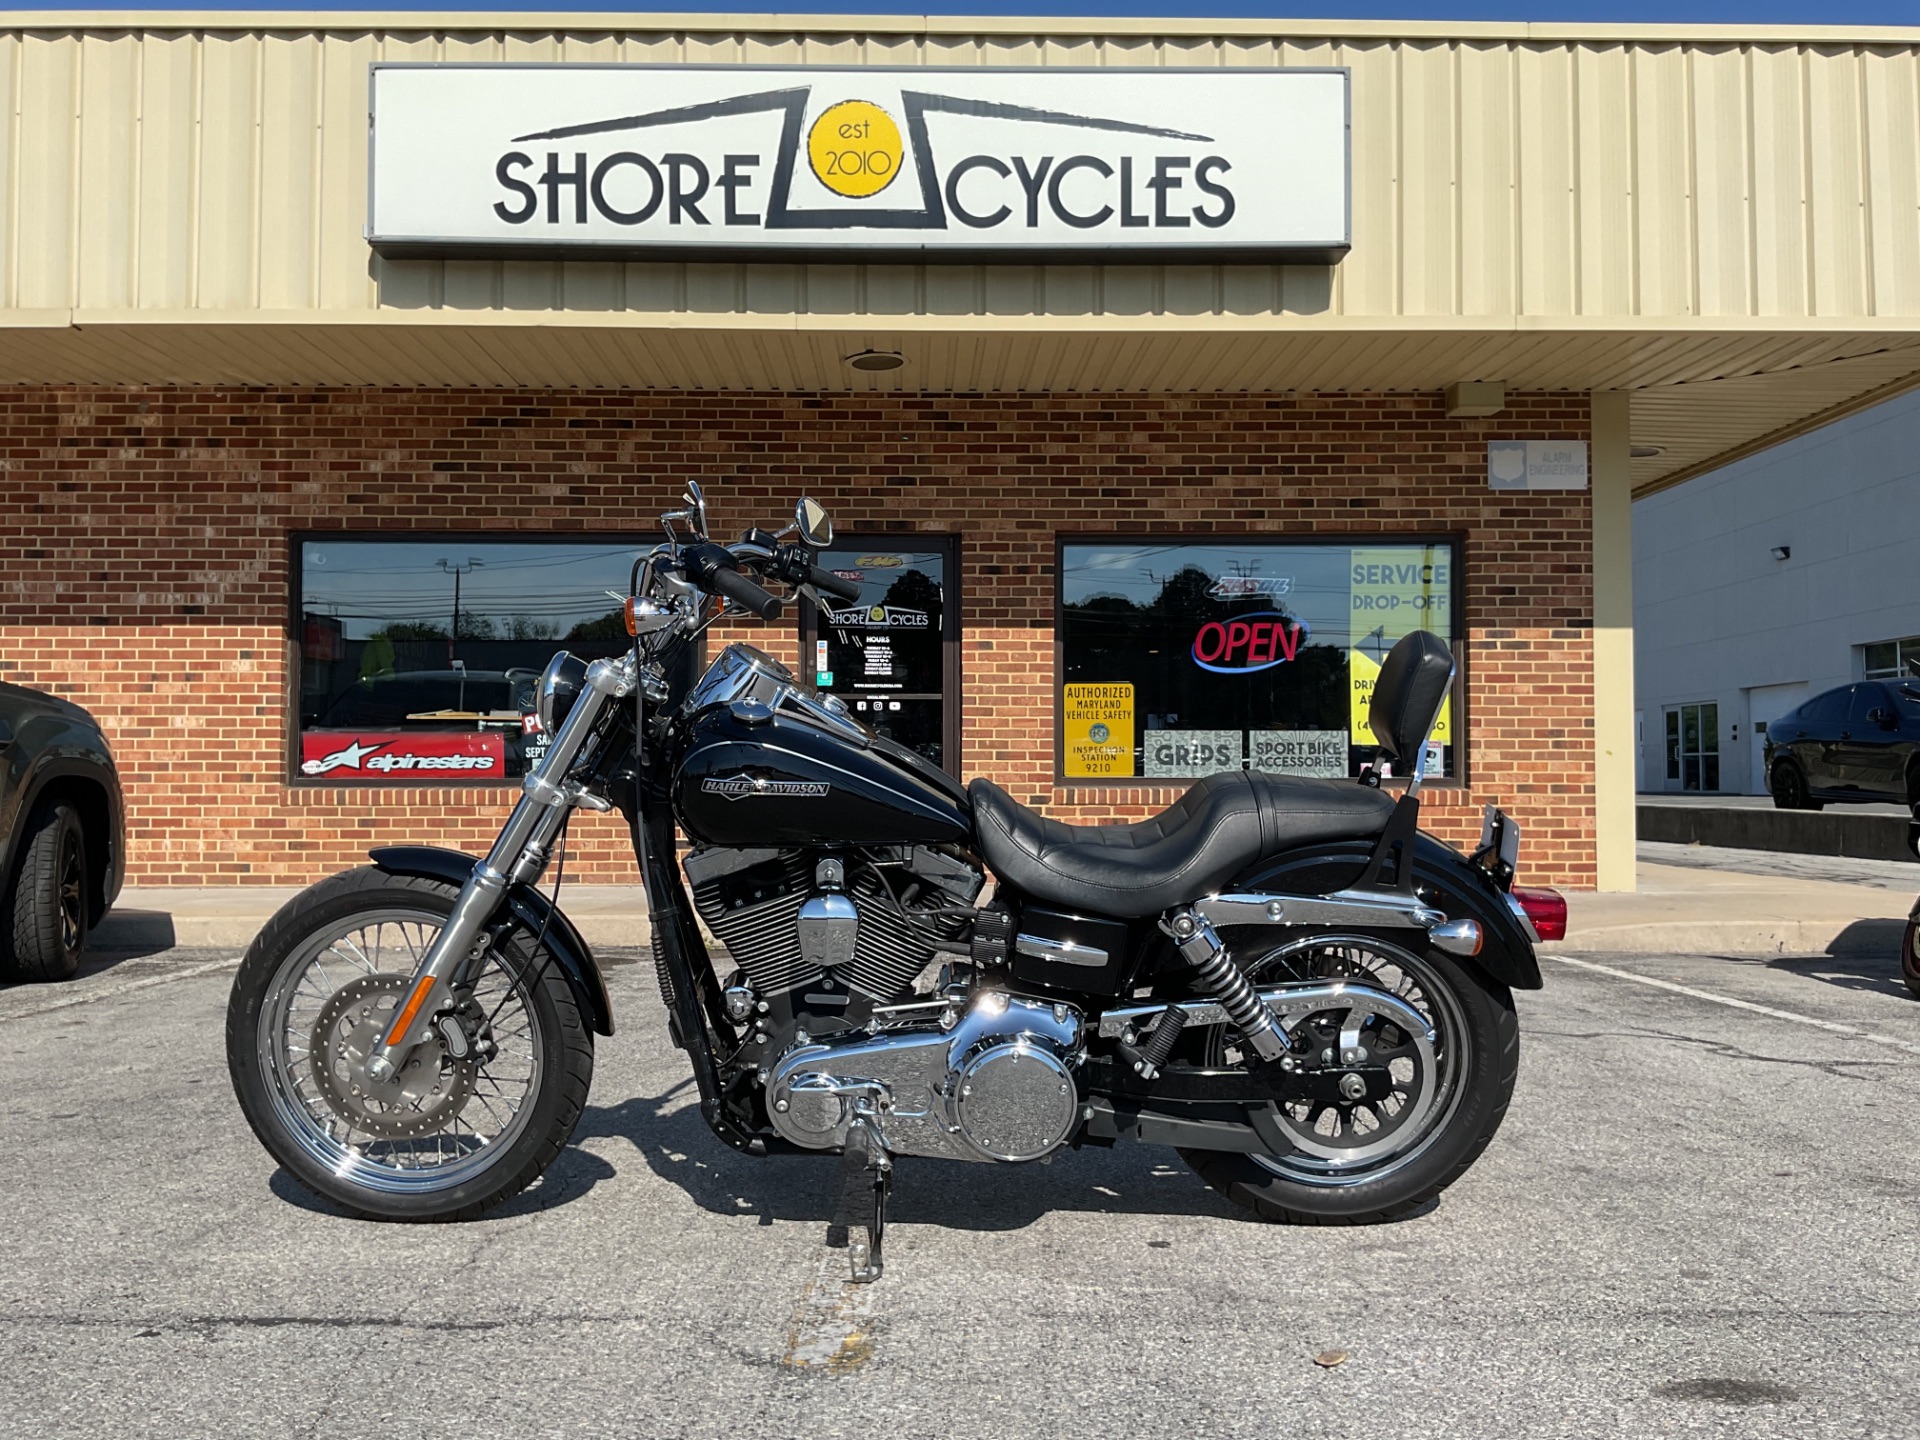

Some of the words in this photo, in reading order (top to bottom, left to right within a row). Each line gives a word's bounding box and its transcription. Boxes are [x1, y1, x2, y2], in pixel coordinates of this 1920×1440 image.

[838, 120, 870, 139] est
[825, 150, 892, 176] 2010
[493, 151, 761, 225] SHORE
[945, 155, 1236, 228] CYCLES
[1542, 452, 1572, 462] ALARM
[1529, 464, 1585, 475] ENGINEERING
[1352, 564, 1448, 585] SERVICE
[1353, 594, 1447, 610] DROP-OFF
[829, 613, 865, 624] SHORE
[890, 614, 929, 625] CYCLES
[1195, 622, 1300, 661] OPEN
[1067, 687, 1131, 698] AUTHORIZED
[1076, 700, 1121, 709] MARYLAND
[1066, 710, 1100, 720] VEHICLE
[1103, 710, 1132, 720] SAFETY
[525, 747, 545, 758] SEPT
[1073, 746, 1125, 754] INSPECTION
[1256, 742, 1304, 755] SPORT
[1308, 742, 1342, 755] BIKE
[1154, 744, 1231, 766] GRIPS
[366, 753, 495, 773] alpinestars
[1086, 763, 1111, 773] 9210
[1256, 756, 1342, 768] ACCESSORIES
